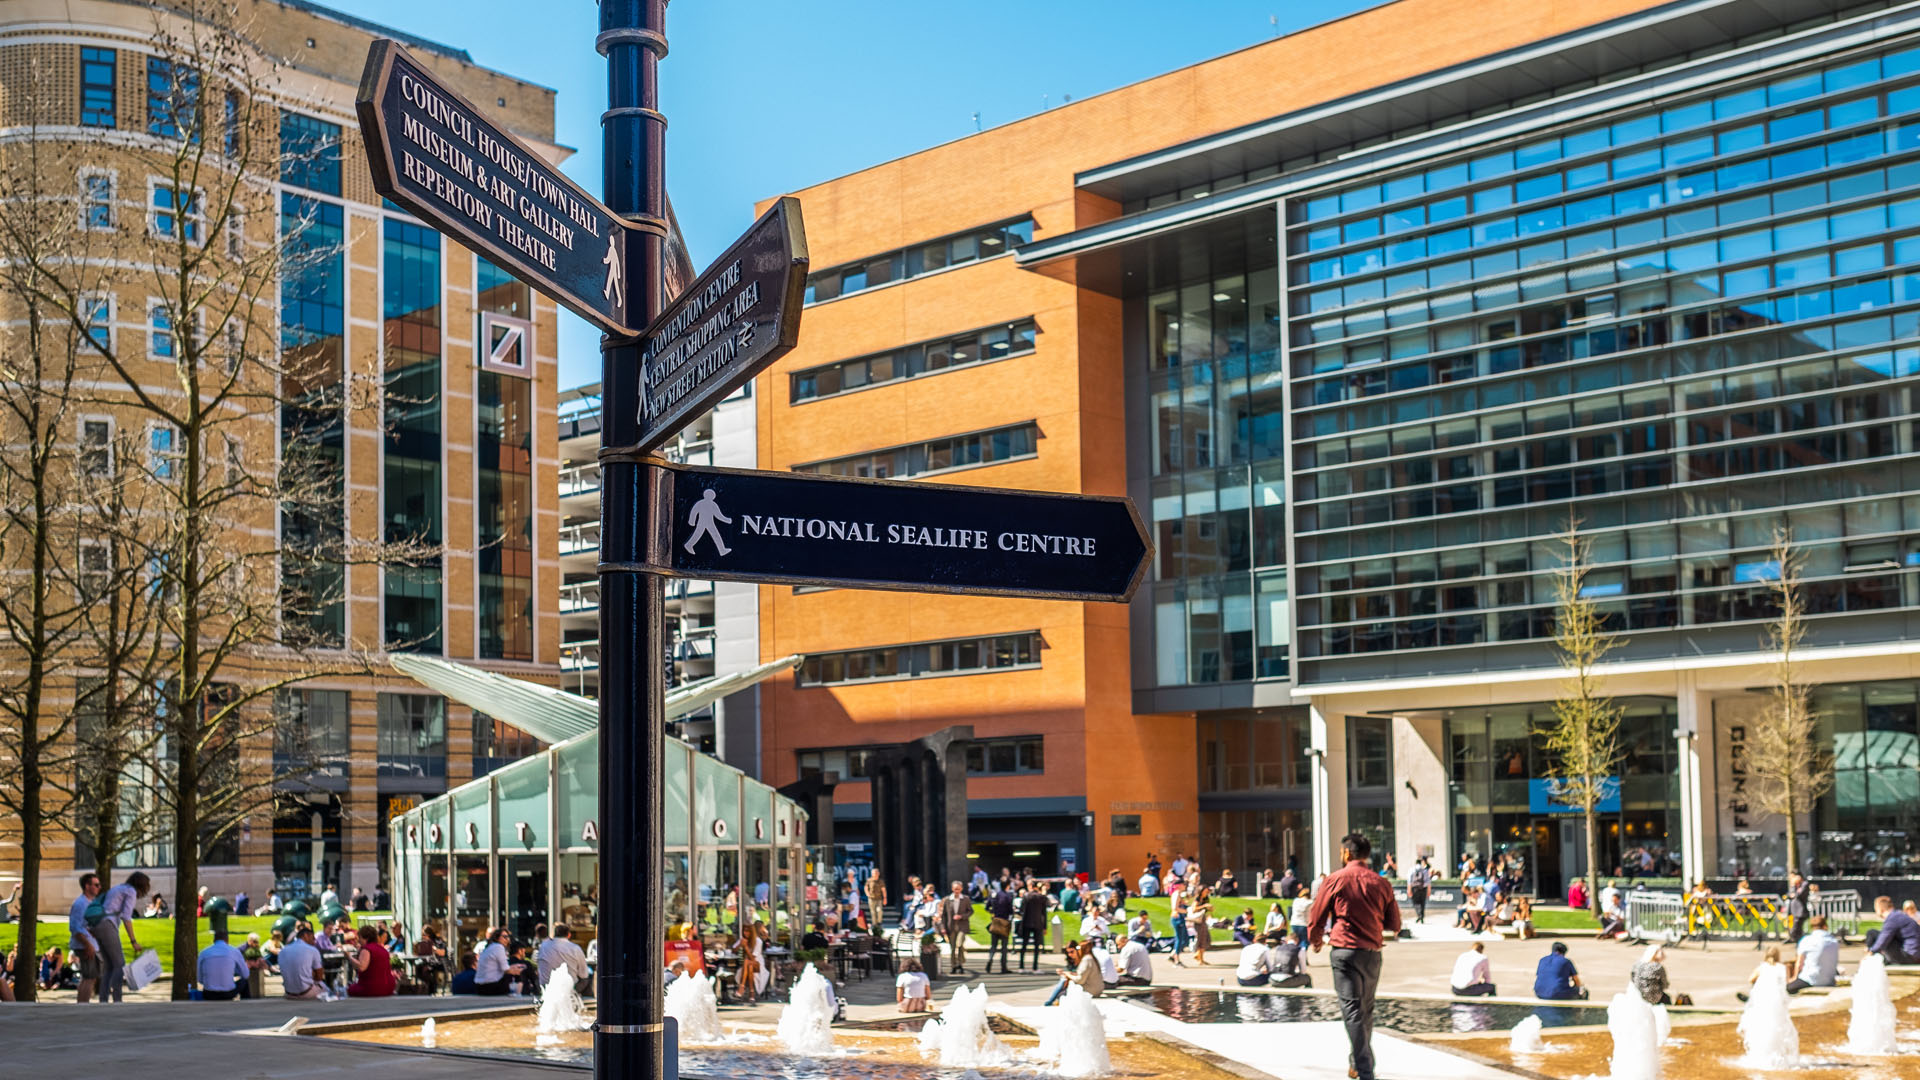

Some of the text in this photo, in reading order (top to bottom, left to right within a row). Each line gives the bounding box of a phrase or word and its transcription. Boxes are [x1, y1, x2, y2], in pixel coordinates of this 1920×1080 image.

[401, 75, 600, 238] COUNCIL HOUSE/TOWN HALL
[403, 112, 574, 251] MUSEUM & ART GALLERY
[403, 150, 557, 271] REPERTORY THEATRE
[651, 281, 760, 389] CENTRAL SHOPPING AREA
[652, 259, 742, 357] CONVENTION CENTRE
[650, 337, 739, 421] NEW STREET STATION
[742, 514, 1096, 557] NATIONAL SEALIFE CENTRE
[407, 820, 598, 845] COSTA
